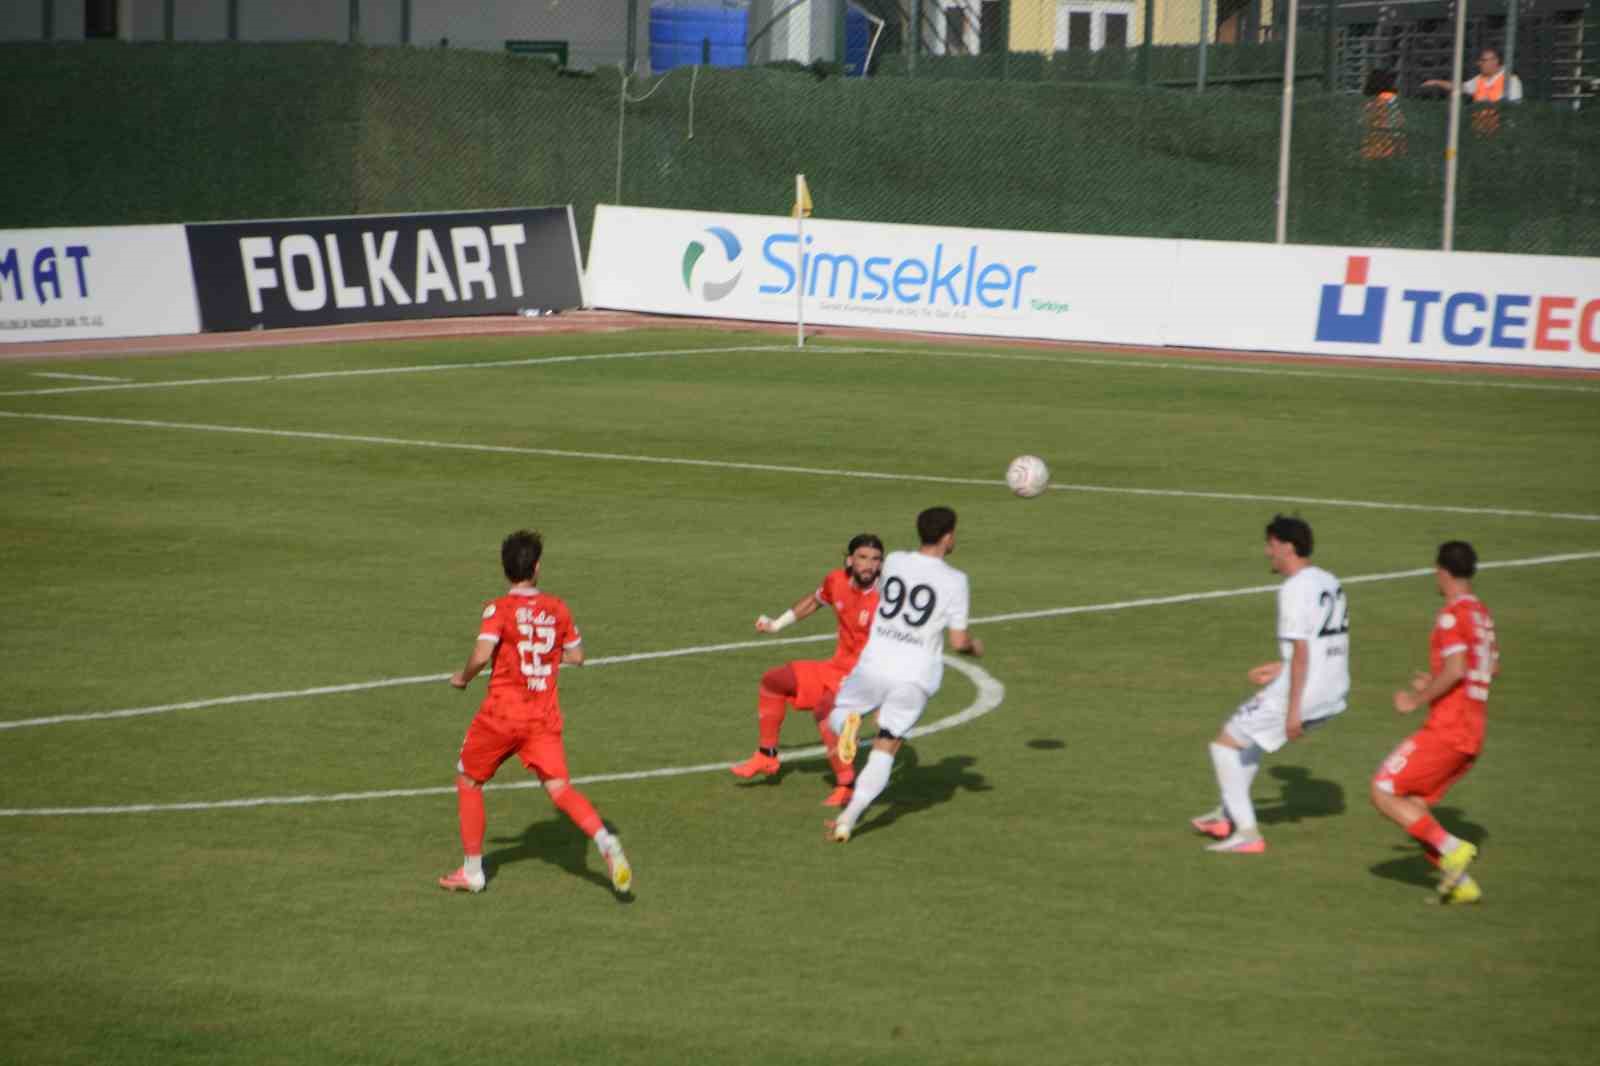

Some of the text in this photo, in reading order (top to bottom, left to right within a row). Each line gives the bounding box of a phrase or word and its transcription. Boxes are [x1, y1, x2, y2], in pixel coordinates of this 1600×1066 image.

[239, 223, 526, 314] FOLKART
[879, 575, 937, 627] 99
[1317, 586, 1349, 638] 22
[517, 624, 556, 677] 22
